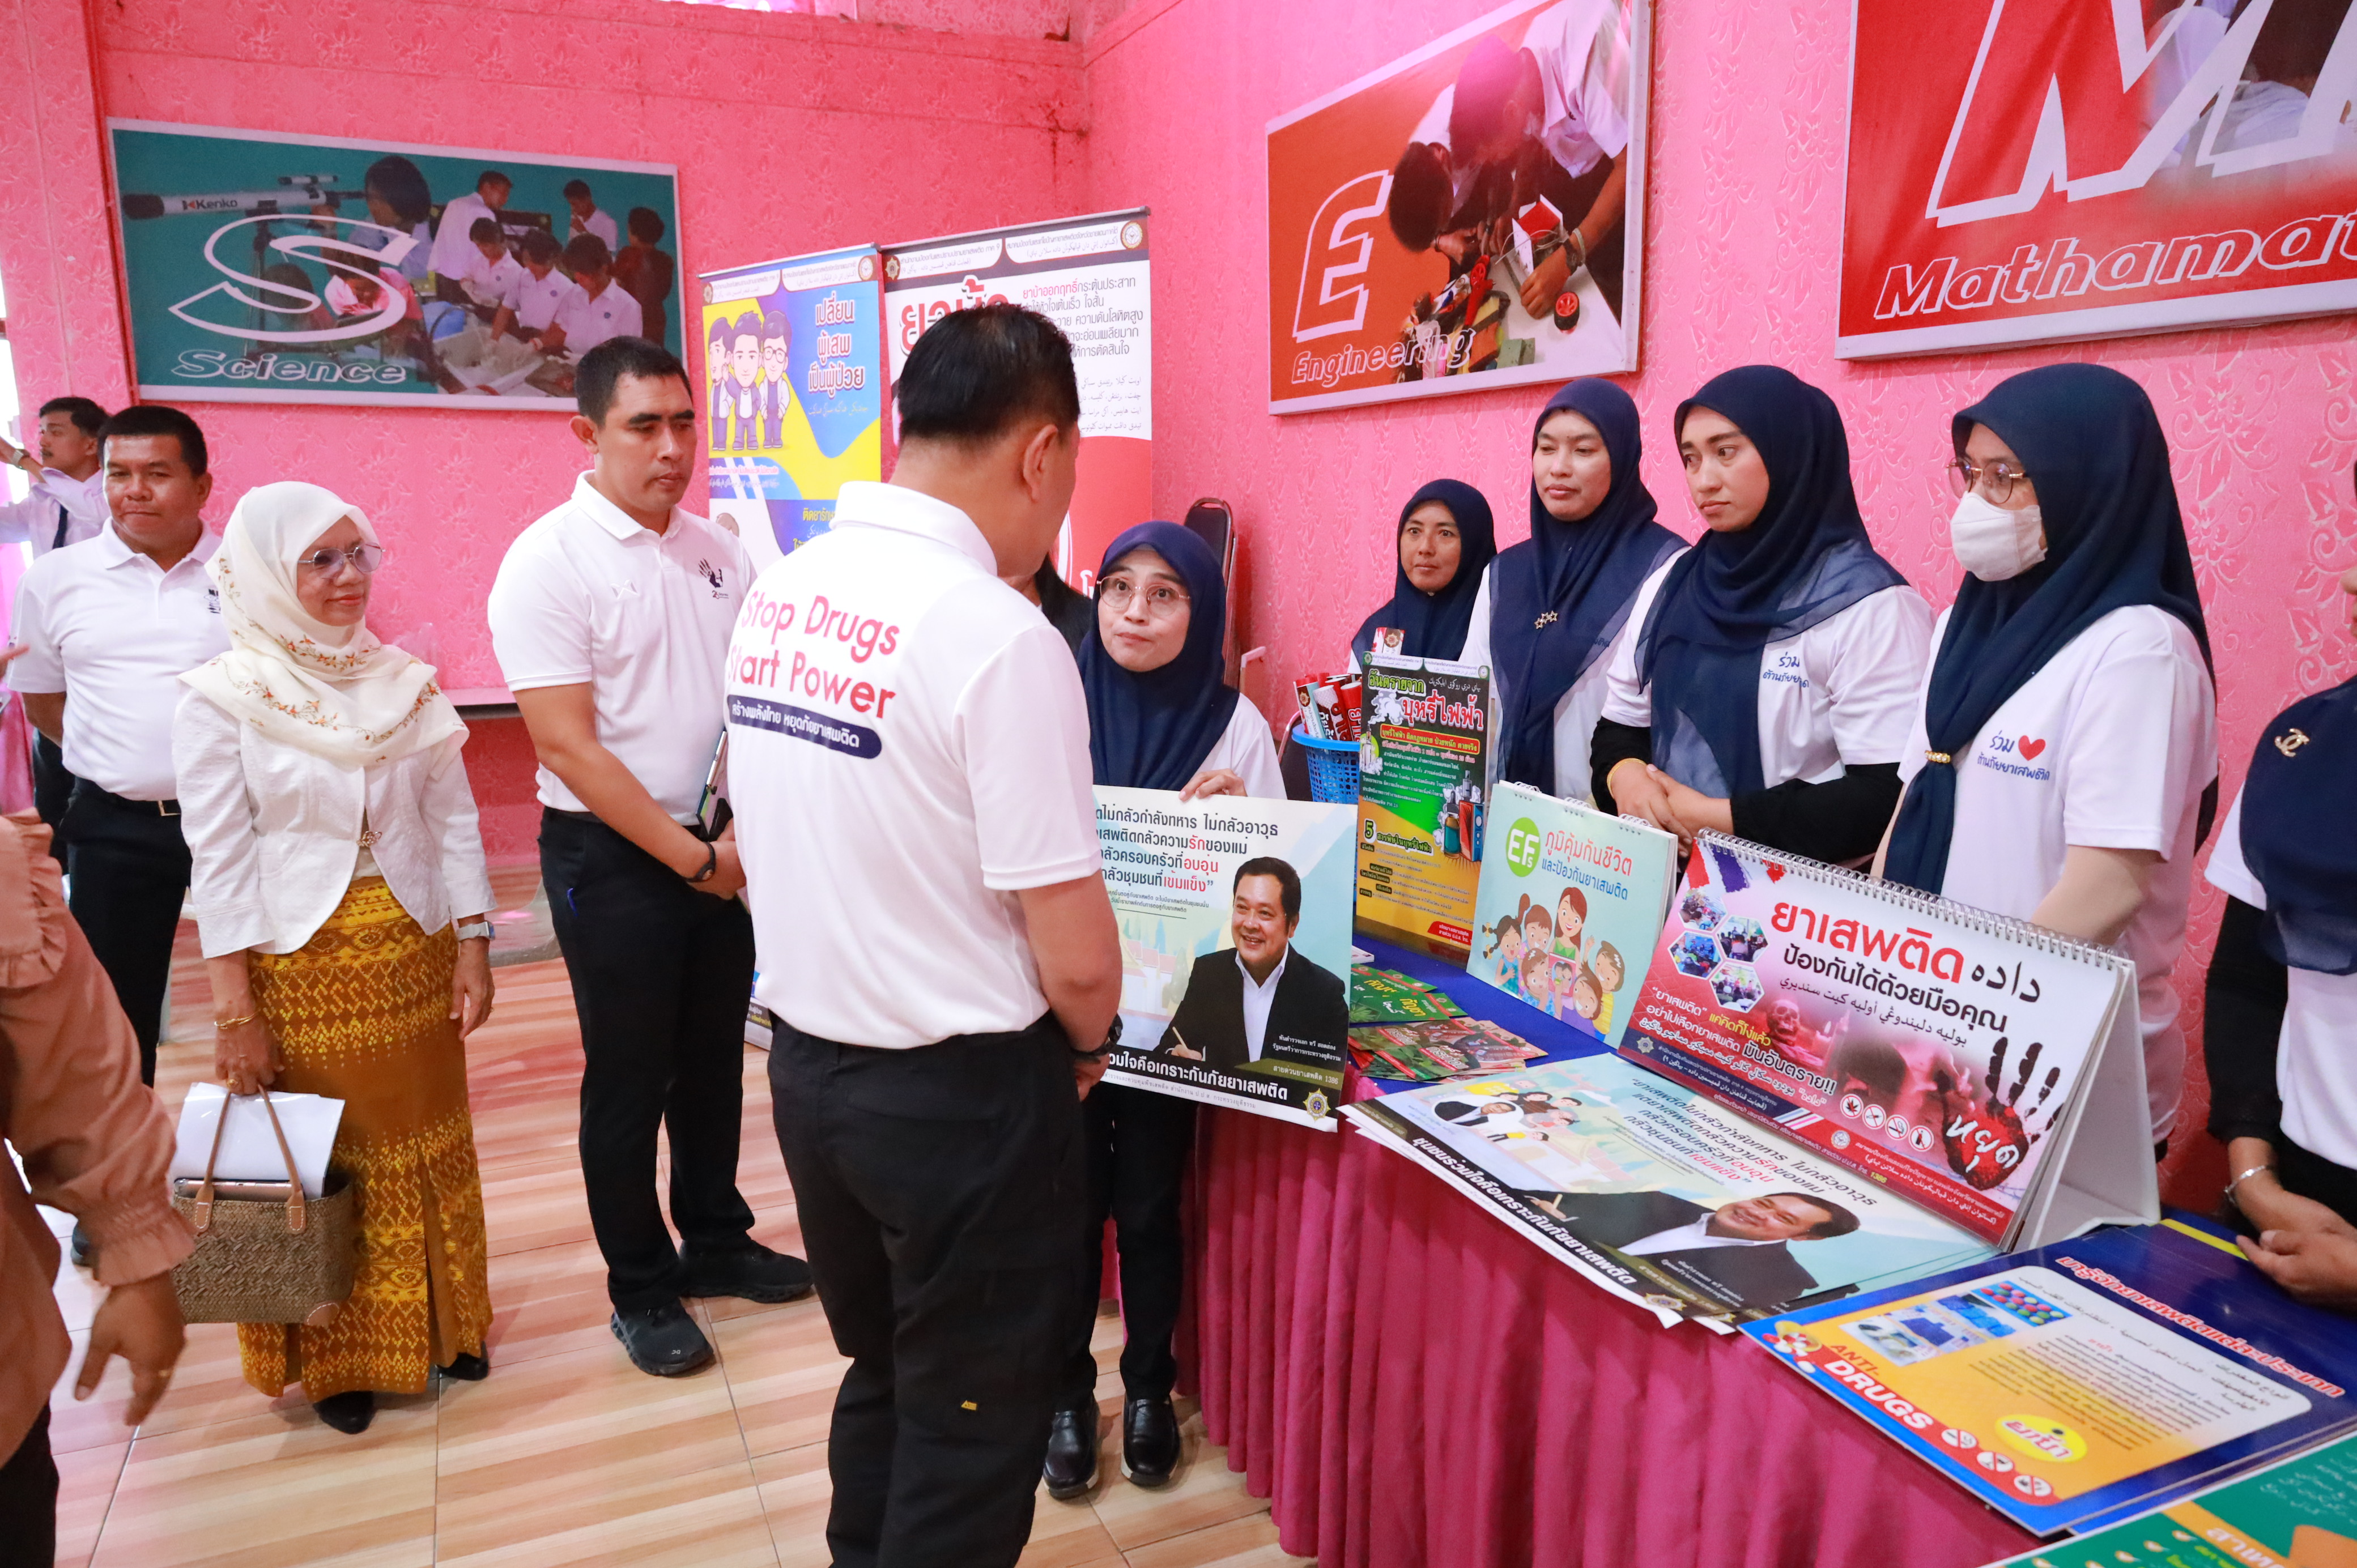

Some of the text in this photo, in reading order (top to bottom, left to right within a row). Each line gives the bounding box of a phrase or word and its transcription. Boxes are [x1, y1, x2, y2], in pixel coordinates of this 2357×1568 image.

[196, 197, 238, 210] Kenko
[1292, 169, 1394, 343] E
[169, 214, 420, 342] S
[815, 291, 855, 326] เปลี่ยน
[1076, 308, 1143, 325] ความดันโลหิตสูง
[171, 349, 407, 384] Science
[818, 330, 851, 367] ผู้เสพ
[1291, 327, 1476, 389] Engineering
[809, 364, 865, 398] เป็นผู้ป่วย
[741, 590, 900, 663] Stop Drugs
[1779, 651, 1799, 667] ร่วม
[789, 651, 896, 718] Power
[1369, 670, 1424, 693] อันตรายจาก
[1402, 689, 1484, 730] บุหรี่ไฟฟ้า
[1990, 730, 2015, 752] ร่วม
[1977, 752, 2049, 780] ต้านภัยยาเสพติด
[1204, 813, 1278, 839] ไม่กลัวอาวุธ
[1365, 820, 1373, 839] 5
[1545, 830, 1632, 876] ภูมิคุ้มกันชีวิต
[1542, 858, 1628, 901] และป้องกันยาเสพติด
[1771, 902, 1964, 984] ยาเสพติด
[1784, 944, 2007, 1033] ป้องกันได้ด้วยมือคุณ
[1971, 961, 2040, 1003] داده
[1646, 1004, 1837, 1095] อย่าไปเลือกยาเสพติด มันอันตราย!!
[1709, 1012, 1771, 1046] แค่คิดก็โง่แล้ว
[1273, 1065, 1339, 1085] สายด่วนยาเสพติด 1386
[1632, 1092, 1826, 1193] แต่ยาเสพติดกลัวความรักของแม่
[1639, 1109, 1775, 1183] กลัวครอบครัวที่อบอุ่น
[1946, 1114, 2019, 1173] หยุด
[1790, 1160, 1878, 1206] ไม่กลัวอาวุธ
[1870, 1171, 1887, 1183] 1386
[1413, 1139, 1637, 1285] ชุมชนร่วมใจคือเกราะกันภัยยาเสพติด
[2056, 1256, 2346, 1398] มารู้จักยาเสพติดแต่ละประเภท
[1831, 1343, 1880, 1376] ANTI-
[1824, 1360, 1934, 1429] DRUGS
[2003, 1418, 2073, 1459] ยาบ้า
